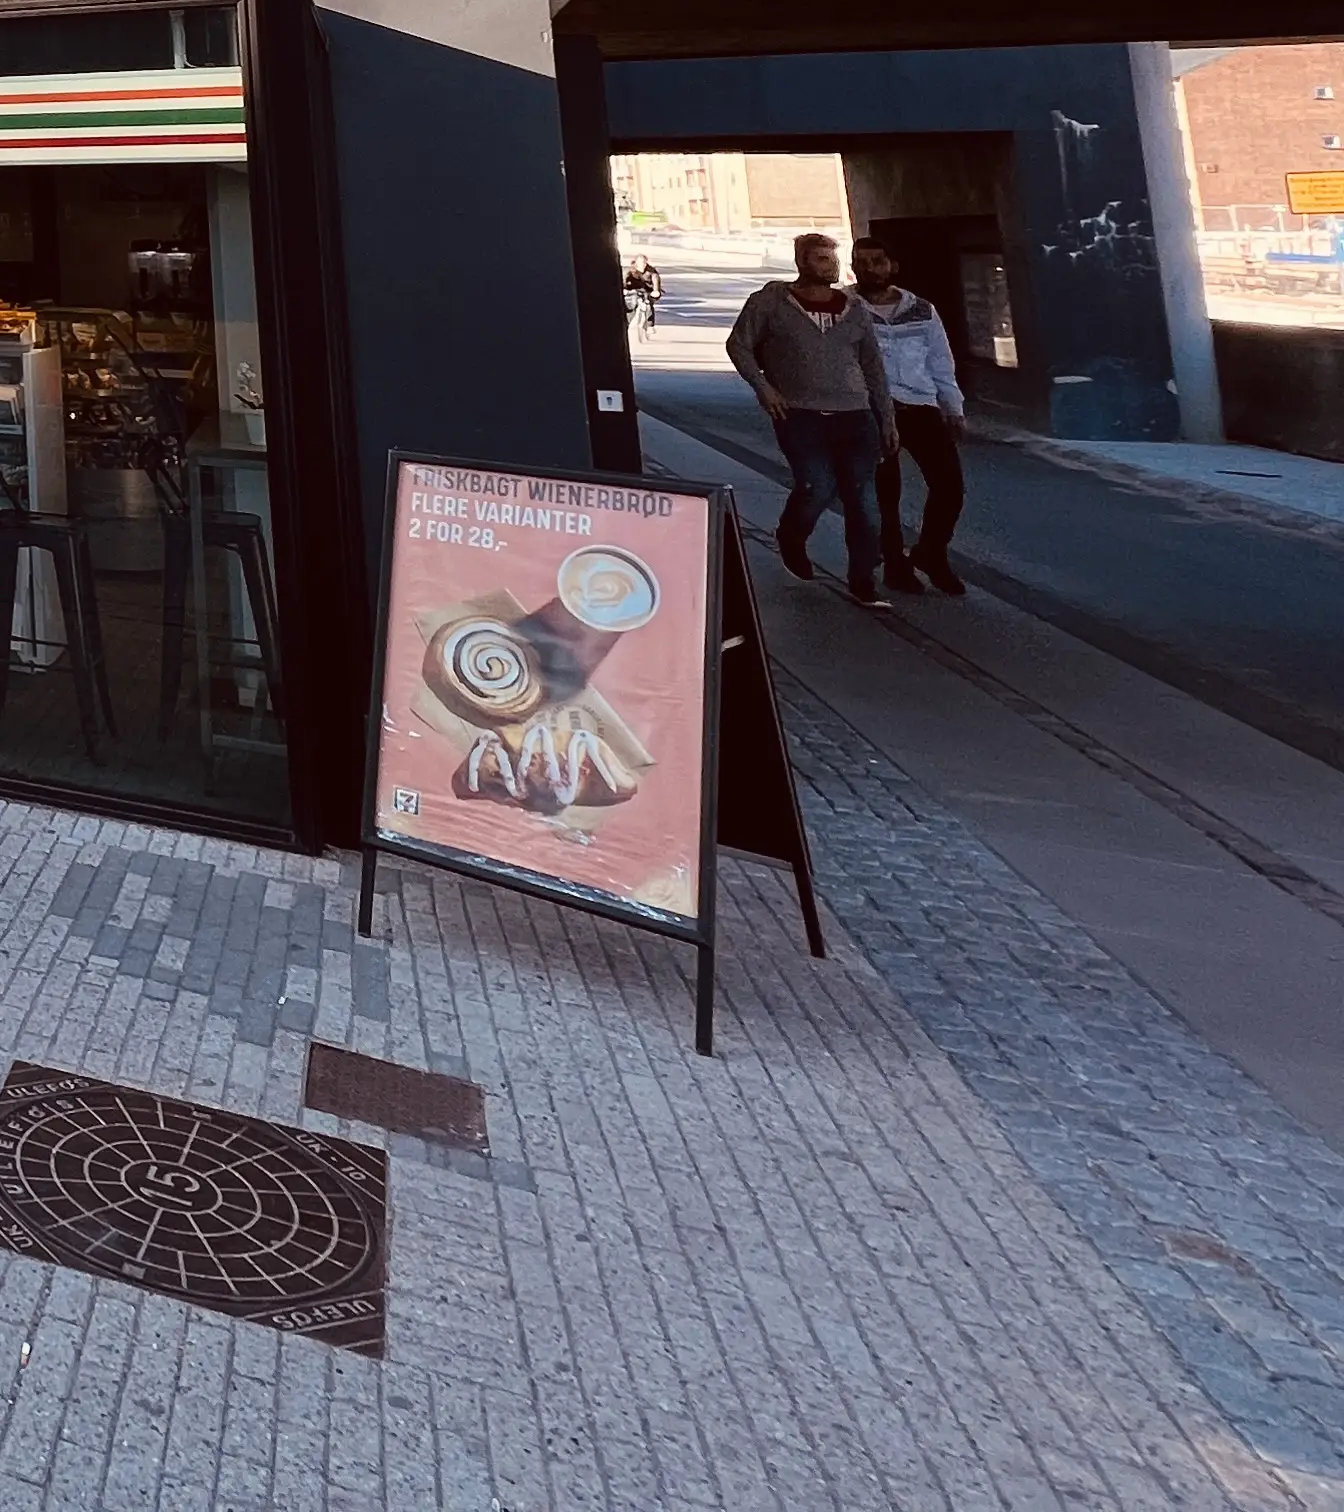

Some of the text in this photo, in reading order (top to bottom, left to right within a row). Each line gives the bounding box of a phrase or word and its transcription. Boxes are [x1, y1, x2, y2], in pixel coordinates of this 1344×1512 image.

[411, 491, 592, 536] FLERE VARIANTER
[413, 467, 673, 519] FRISKBAGT WIENERBRØD
[408, 518, 421, 538] 2
[426, 520, 463, 545] FOR
